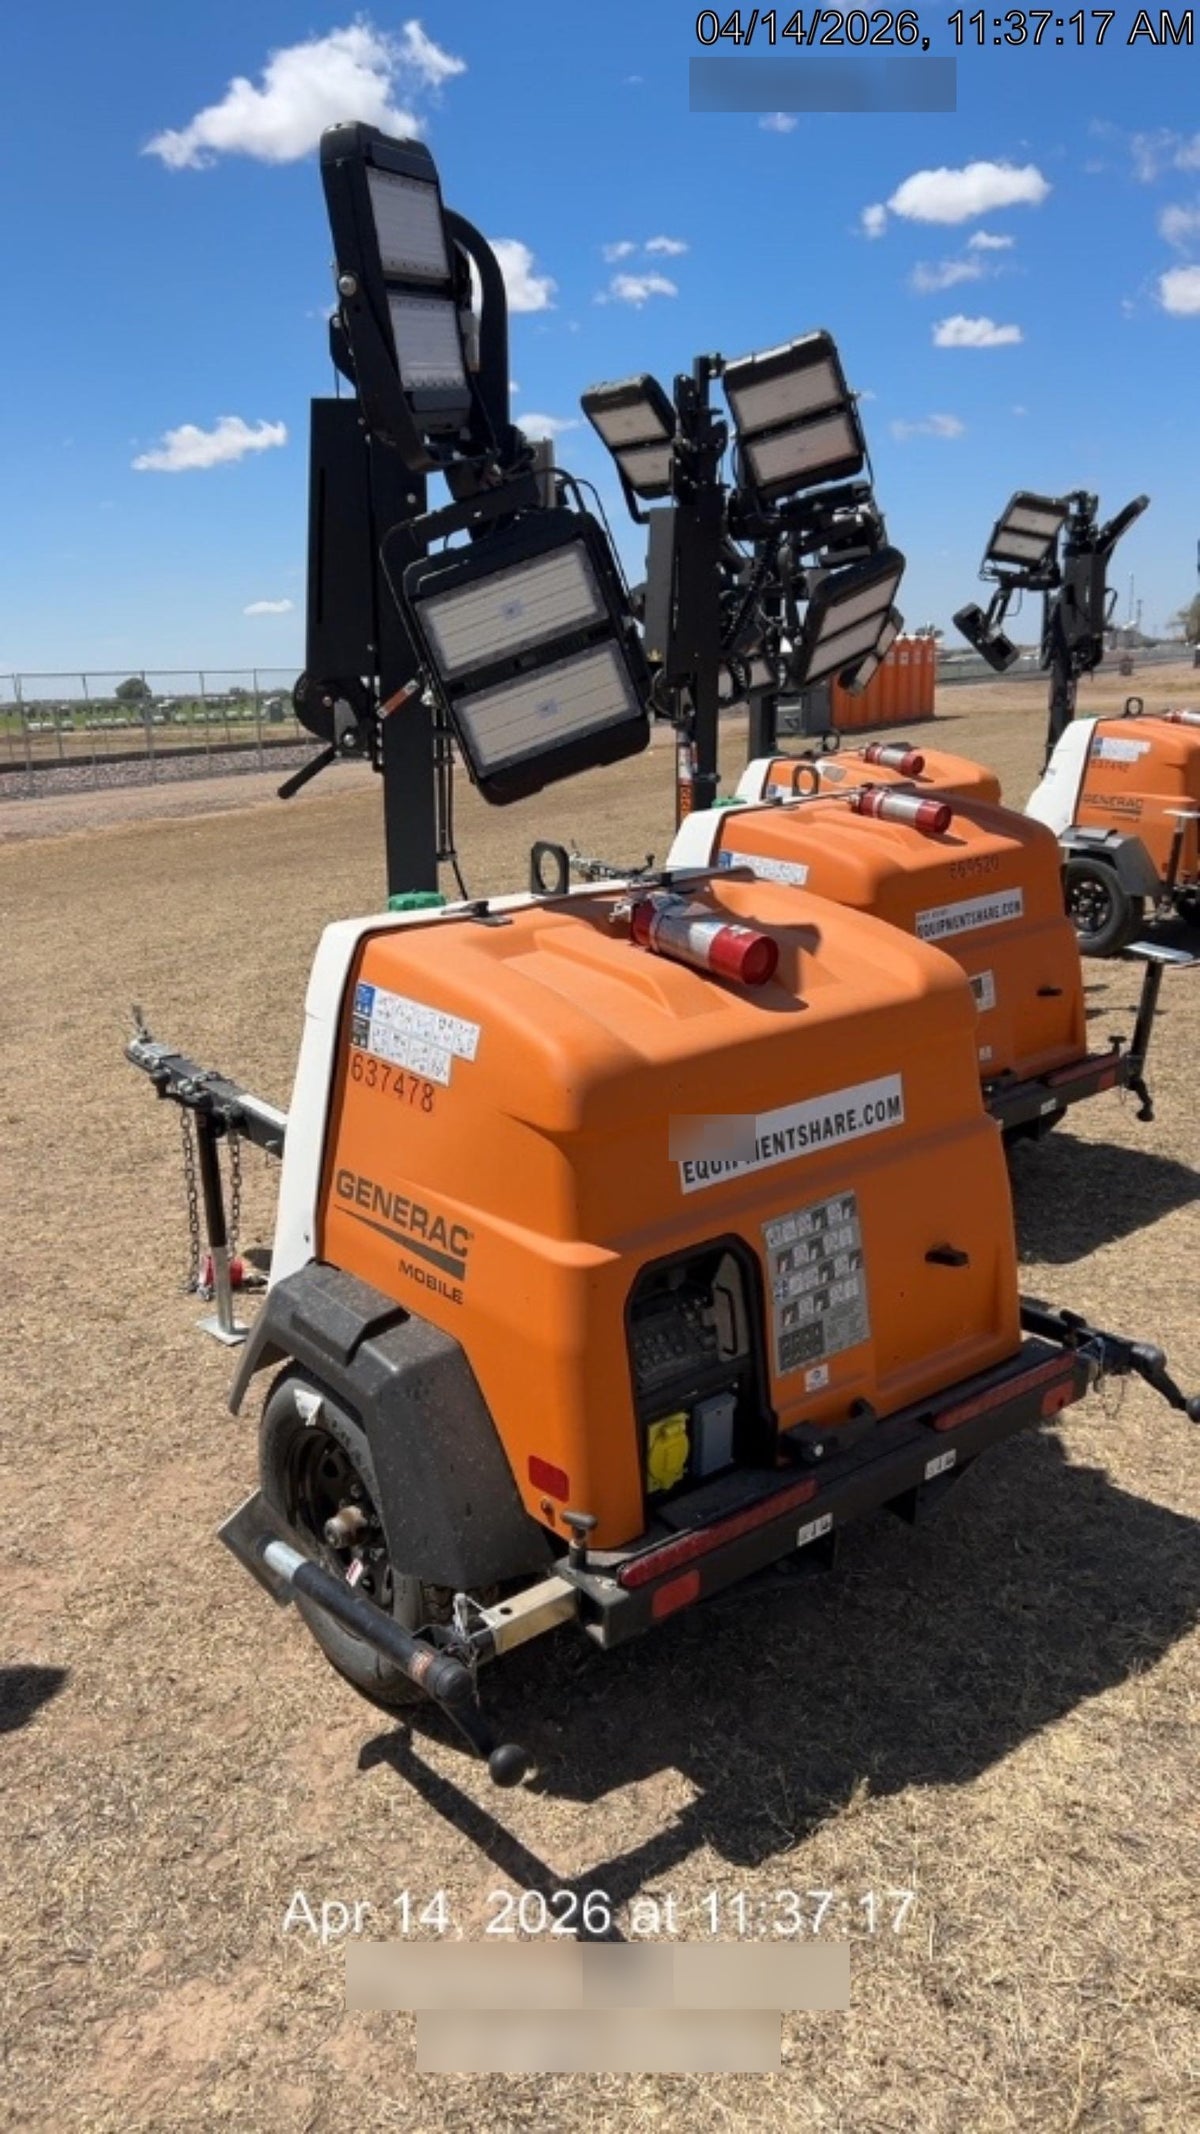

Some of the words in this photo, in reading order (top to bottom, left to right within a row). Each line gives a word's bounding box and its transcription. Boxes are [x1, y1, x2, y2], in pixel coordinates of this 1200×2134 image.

[351, 1054, 435, 1112] 637478
[683, 1096, 901, 1184] EQUENTSHARE.COM
[336, 1168, 469, 1258] GENERAC
[398, 1259, 464, 1305] MOBILE
